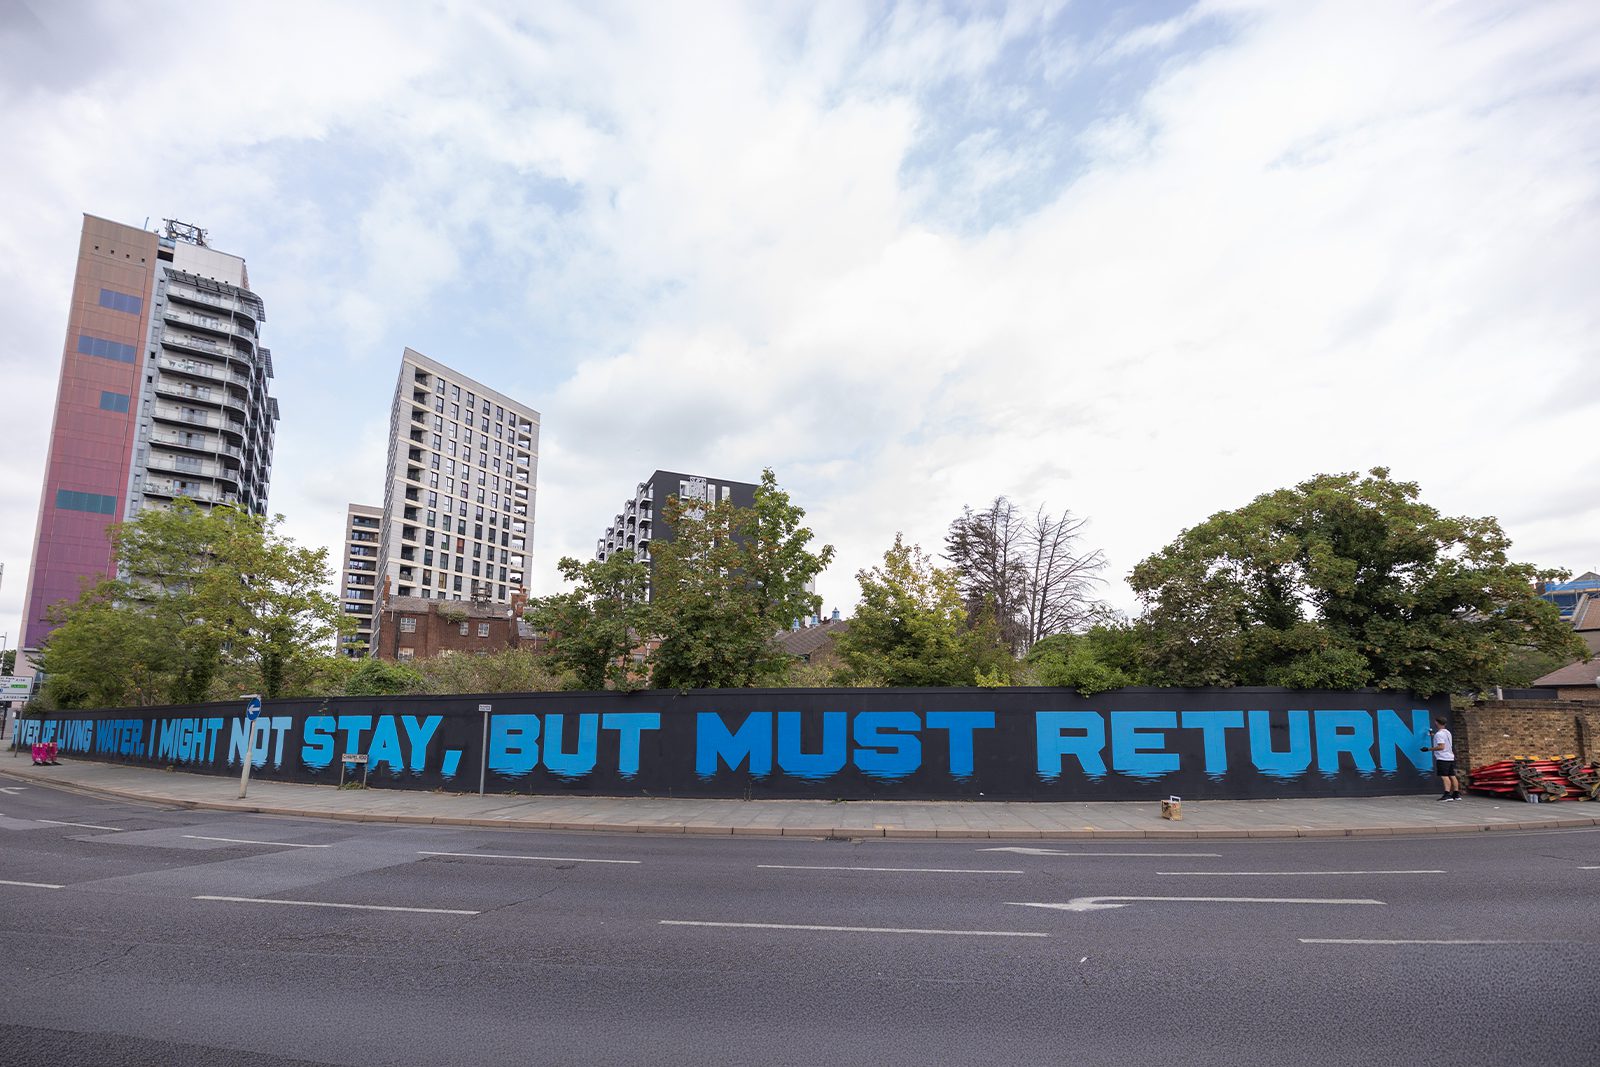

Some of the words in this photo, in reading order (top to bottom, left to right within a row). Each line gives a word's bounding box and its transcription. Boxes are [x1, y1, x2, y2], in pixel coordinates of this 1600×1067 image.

[12, 719, 41, 746] RVER
[42, 719, 57, 744] OF
[57, 719, 93, 752] LIVING
[148, 718, 157, 758] I
[158, 717, 224, 764] MIGHT
[228, 716, 292, 771] NOT
[302, 714, 463, 781] STAY,
[488, 712, 660, 782] BUT
[695, 711, 996, 784] MUST
[1035, 709, 1434, 783] RETURN
